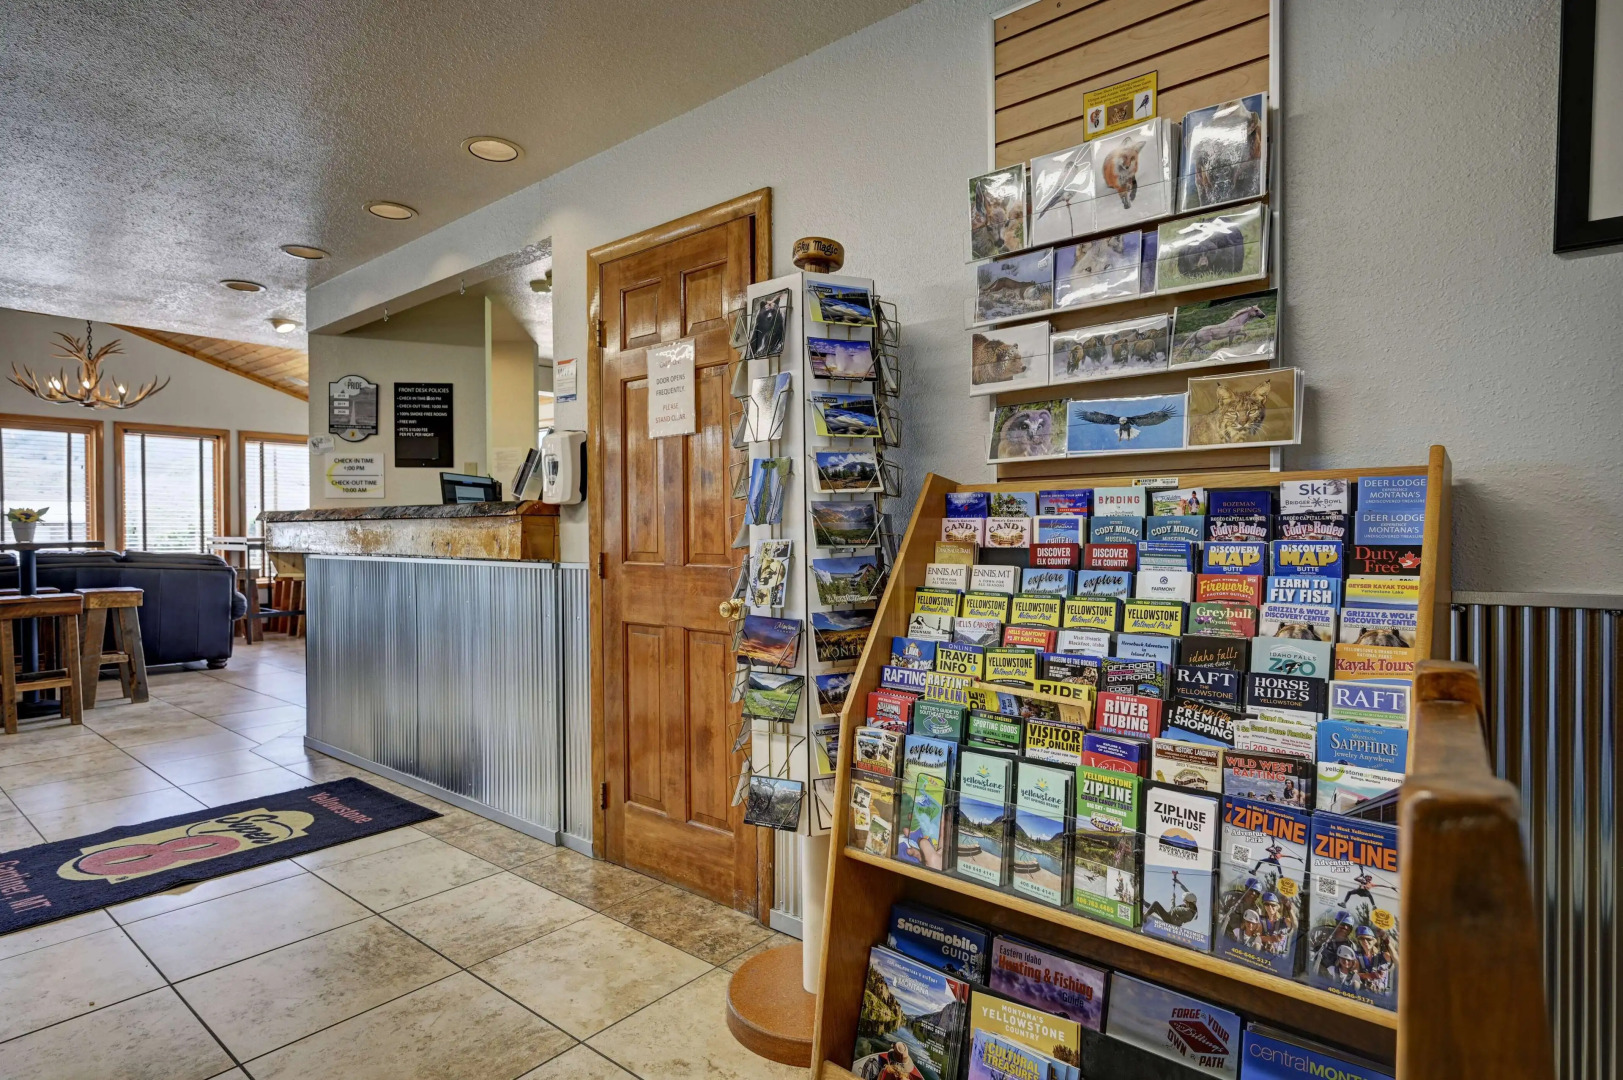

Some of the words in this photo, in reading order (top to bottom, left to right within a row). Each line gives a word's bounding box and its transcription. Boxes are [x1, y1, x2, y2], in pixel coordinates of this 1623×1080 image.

[813, 240, 838, 256] Magic
[348, 382, 362, 390] PRIDE
[656, 378, 670, 386] DOOR
[670, 374, 686, 383] OPENS
[662, 402, 678, 411] PLEASE
[656, 416, 670, 424] STAND
[1299, 483, 1327, 496] Ski
[1364, 479, 1389, 488] DEER
[1392, 478, 1427, 487] LODGE
[1098, 496, 1140, 505] BIRDING
[944, 522, 979, 533] CANDY
[988, 522, 1027, 533] CANDY
[1094, 526, 1114, 536] CODY
[1115, 525, 1139, 537] MURAL
[1151, 526, 1171, 536] CODY
[1172, 525, 1199, 537] MURAL
[1210, 524, 1232, 538] Cody
[1238, 522, 1267, 537] Rodeo
[1037, 548, 1070, 557] DISCOVER
[1092, 548, 1128, 559] DISCOVER
[1208, 550, 1260, 566] MAP
[1280, 550, 1338, 566] MAP
[1354, 546, 1398, 562] Duty
[1364, 560, 1400, 573] Free
[1084, 574, 1123, 592] explore
[1200, 580, 1254, 596] Fireworks
[1274, 579, 1310, 589] LEARN
[1312, 579, 1328, 589] TO
[917, 596, 954, 606] YELLOWSTONE
[966, 599, 1006, 610] YELLOWSTONE
[1270, 589, 1297, 602] FLY
[1299, 589, 1332, 604] FISH
[1015, 602, 1057, 613] YELLOWSTONE
[1067, 605, 1113, 617] YELLOWSTONE
[1128, 609, 1178, 621] YELLOWSTONE
[1196, 607, 1253, 619] Greybull
[1265, 612, 1302, 620] DISCOVERY
[948, 644, 973, 652] ONLINE
[940, 650, 978, 664] TRAVEL
[988, 657, 1032, 668] YELLOWSTONE
[940, 661, 967, 673] INFO
[1107, 662, 1155, 671] OFF-ROAD
[1335, 658, 1376, 674] Kayak
[1378, 660, 1414, 671] Tours
[883, 668, 926, 686] RAFTING
[1107, 674, 1156, 682] ON-ROAD
[1177, 669, 1234, 686] RAFT
[1254, 676, 1310, 691] HORSE
[1040, 684, 1083, 700] RIDE
[1177, 687, 1233, 699] YELLOWSTONE
[1254, 687, 1309, 702] RIDES
[1335, 688, 1404, 710] RAFT
[1105, 699, 1148, 718] RIVER
[1102, 713, 1148, 732] TUBING
[1176, 706, 1234, 732] PREMIER
[1029, 725, 1080, 744] VISITOR
[1174, 715, 1233, 740] SHOPPING
[1028, 737, 1045, 747] TIPS
[1048, 740, 1080, 753] ONLINE
[1330, 732, 1398, 756] SAPPHIRE
[857, 761, 872, 770] BEAR
[873, 764, 892, 776] WORLD
[1226, 756, 1256, 768] WILD
[1259, 760, 1294, 773] WEST
[1083, 770, 1132, 788] YELLOWSTONE
[1233, 767, 1286, 782] RAFTING
[1020, 789, 1064, 804] yellowstone
[1082, 779, 1132, 804] ZIPLINE
[307, 791, 372, 824] Yellowstone
[1154, 802, 1206, 824] ZIPLINE
[1160, 814, 1184, 828] WITH
[1186, 820, 1201, 832] US!
[1232, 806, 1306, 845] ZIPLINE
[1315, 834, 1398, 872] ZIPLINE
[897, 918, 978, 953] Snowmobile
[942, 946, 976, 965] GUIDE
[999, 946, 1023, 961] Eastern
[1024, 951, 1042, 966] Idaho
[1001, 1005, 1044, 1024] MONTANA'S
[982, 1007, 1065, 1042] YELLOWSTONE
[1172, 1008, 1201, 1019] FORGE
[1208, 1014, 1230, 1044] YOUR
[1005, 1024, 1040, 1042] COUNTRY
[1167, 1028, 1187, 1056] OWN
[1199, 1056, 1224, 1068] PATH
[988, 1041, 1040, 1075] CULTURAL
